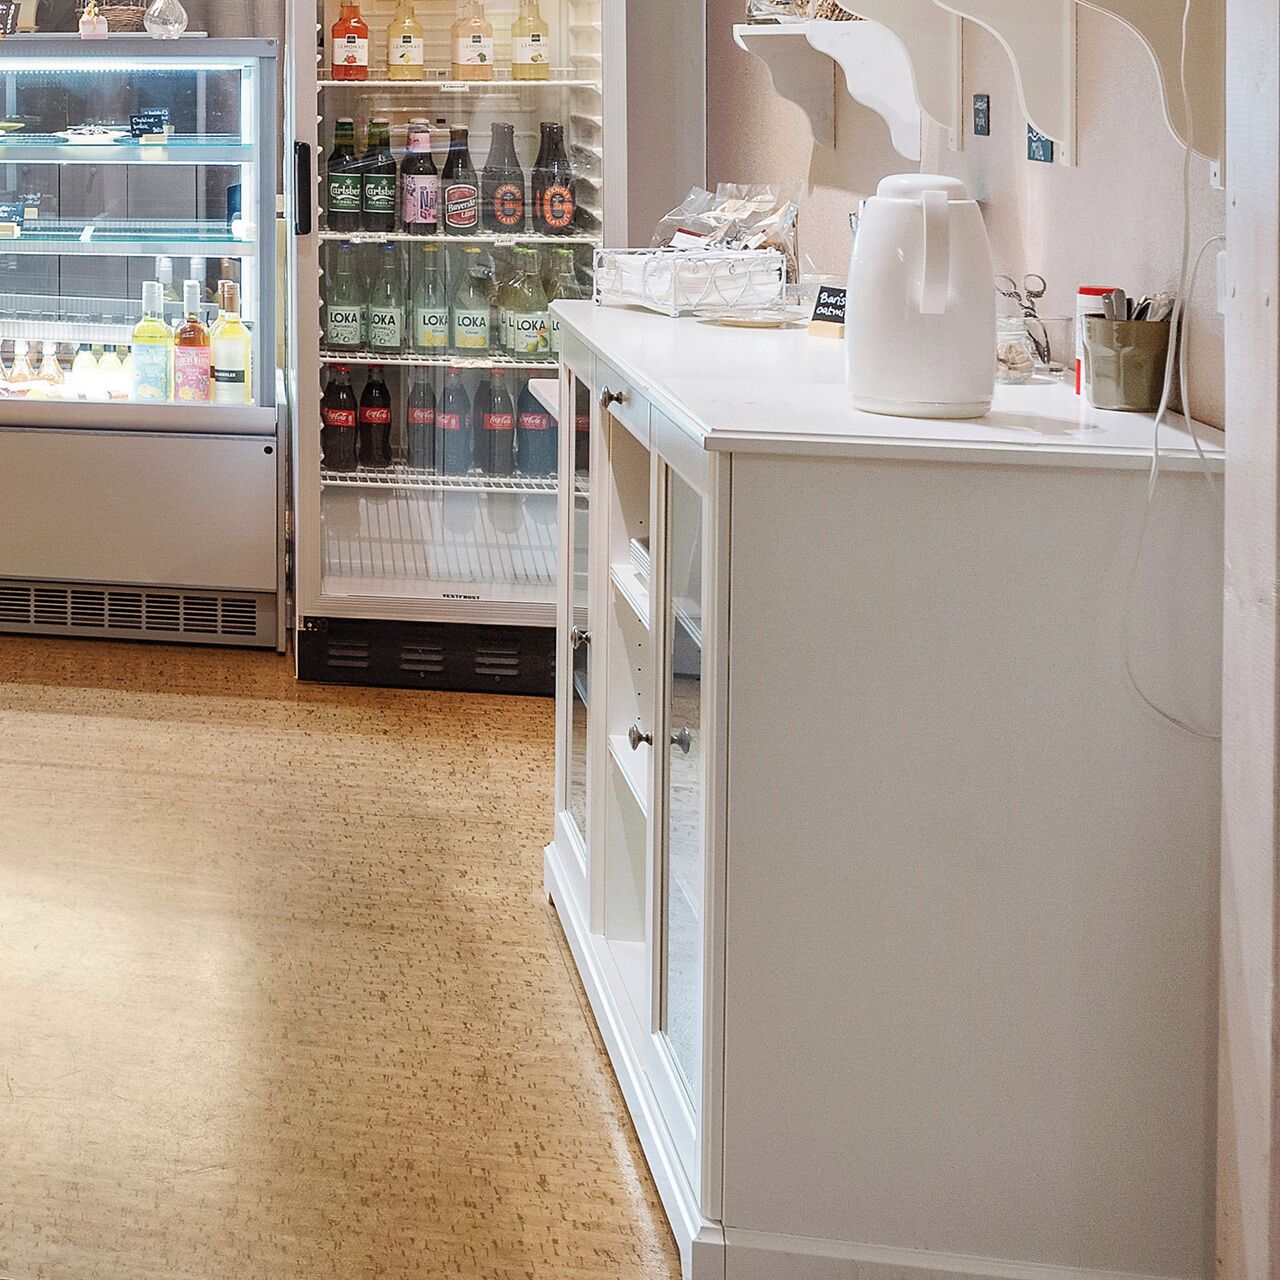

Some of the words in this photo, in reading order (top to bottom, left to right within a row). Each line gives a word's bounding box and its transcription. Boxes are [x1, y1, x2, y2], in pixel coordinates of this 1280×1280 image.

[330, 312, 358, 324] LOKA
[371, 313, 396, 326] OKA
[457, 316, 487, 327] LOKA
[516, 319, 547, 331] LOKA
[365, 409, 388, 420] Coca-Cola
[489, 415, 512, 425] Coca-Cola
